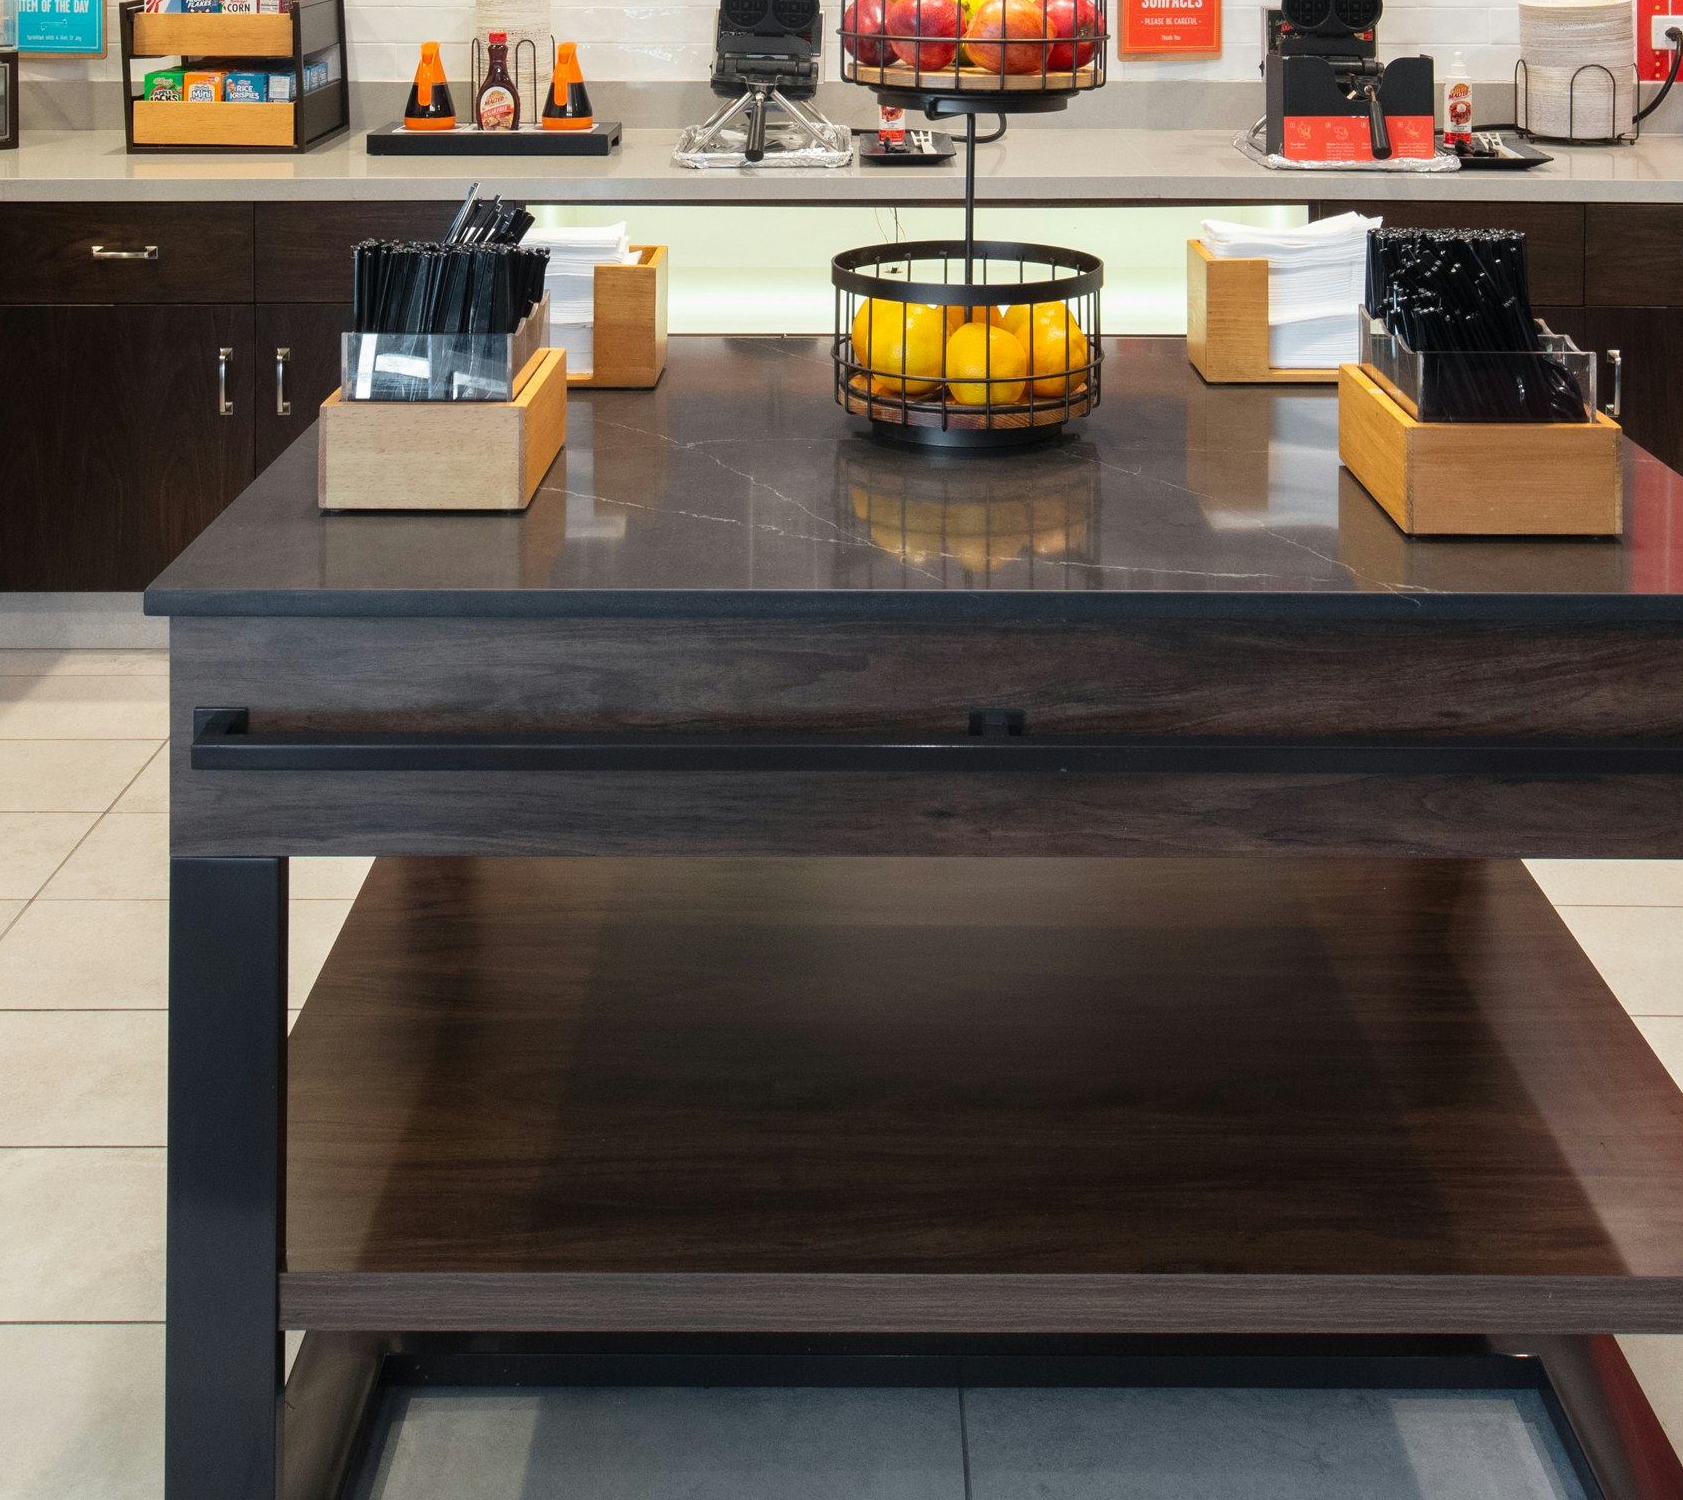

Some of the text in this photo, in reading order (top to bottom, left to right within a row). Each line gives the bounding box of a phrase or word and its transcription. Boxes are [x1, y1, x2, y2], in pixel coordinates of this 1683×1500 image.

[19, 0, 90, 13] ITEM OF THE DAY
[187, 1, 212, 9] FLAKES
[227, 3, 250, 13] CORN
[192, 88, 213, 98] Mini
[237, 85, 254, 93] RICE
[229, 92, 260, 100] KRISPIES
